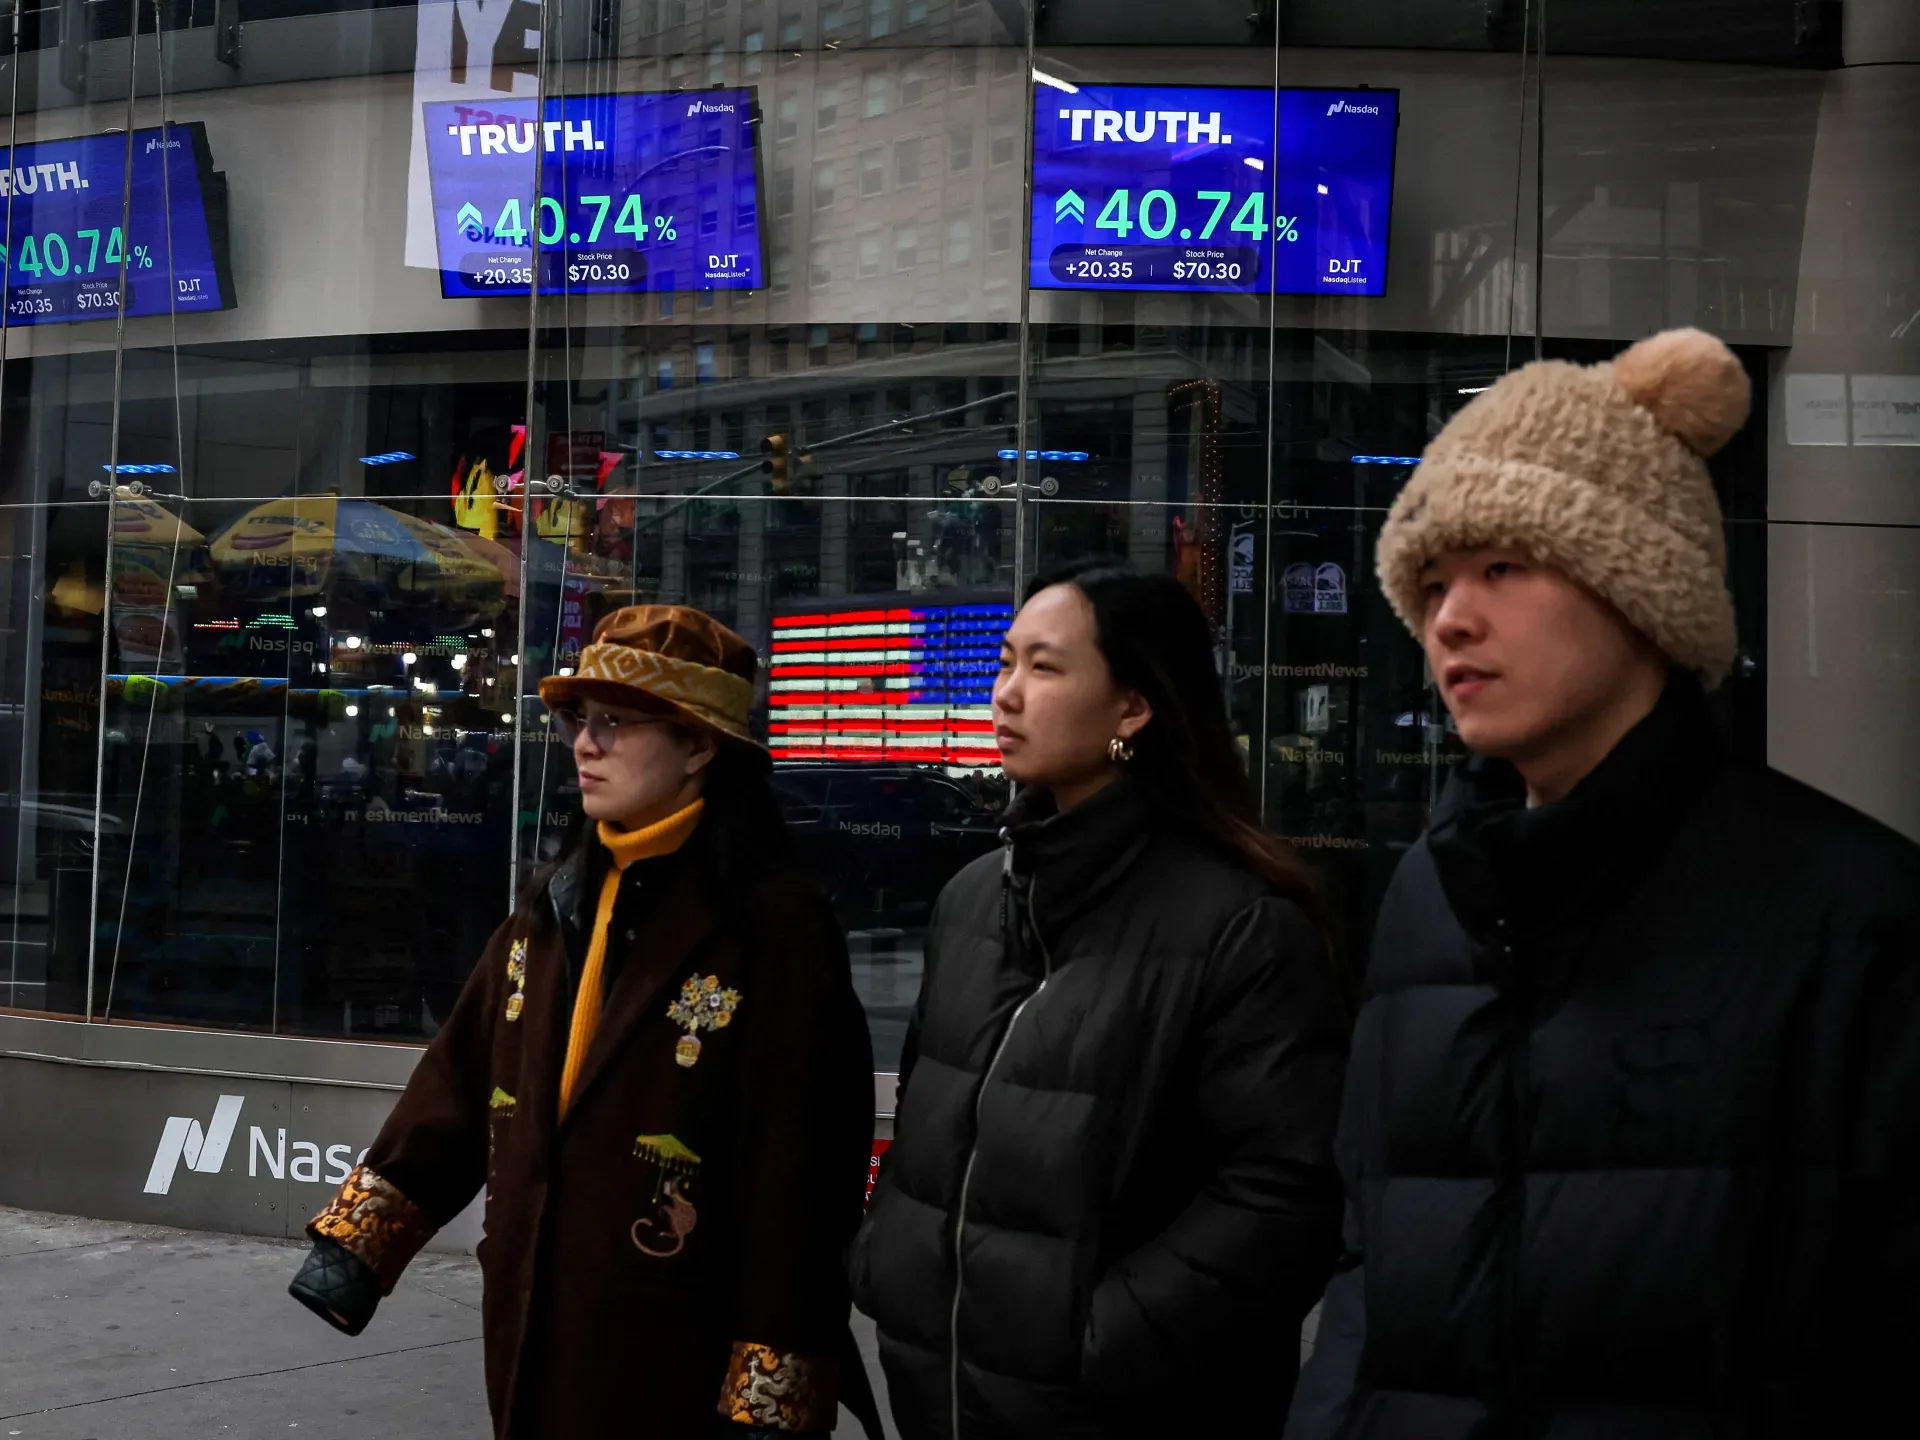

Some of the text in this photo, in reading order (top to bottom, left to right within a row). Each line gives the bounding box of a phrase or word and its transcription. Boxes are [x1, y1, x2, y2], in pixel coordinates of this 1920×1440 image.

[702, 103, 735, 114] Nasdaq
[1344, 104, 1379, 116] Nasdaq
[1059, 109, 1232, 144] TRUTH.
[449, 120, 605, 155] TRUTH.
[500, 256, 522, 264] Change
[577, 252, 612, 261] Stock Price
[1085, 248, 1123, 258] Net Change
[1185, 249, 1224, 258] Stock Price
[708, 254, 739, 269] DJT
[1329, 259, 1362, 273] DJT
[473, 264, 630, 285] +20.35 $70.30
[1065, 261, 1241, 280] +20.35 $70.30
[178, 279, 200, 292] DJT
[9, 298, 53, 314] +20.35
[252, 551, 317, 571] Nasaq
[249, 636, 314, 656] Nasaq
[1281, 747, 1344, 766] Nasdaq
[840, 821, 901, 839] Nasdaq
[1277, 833, 1366, 850] entNews
